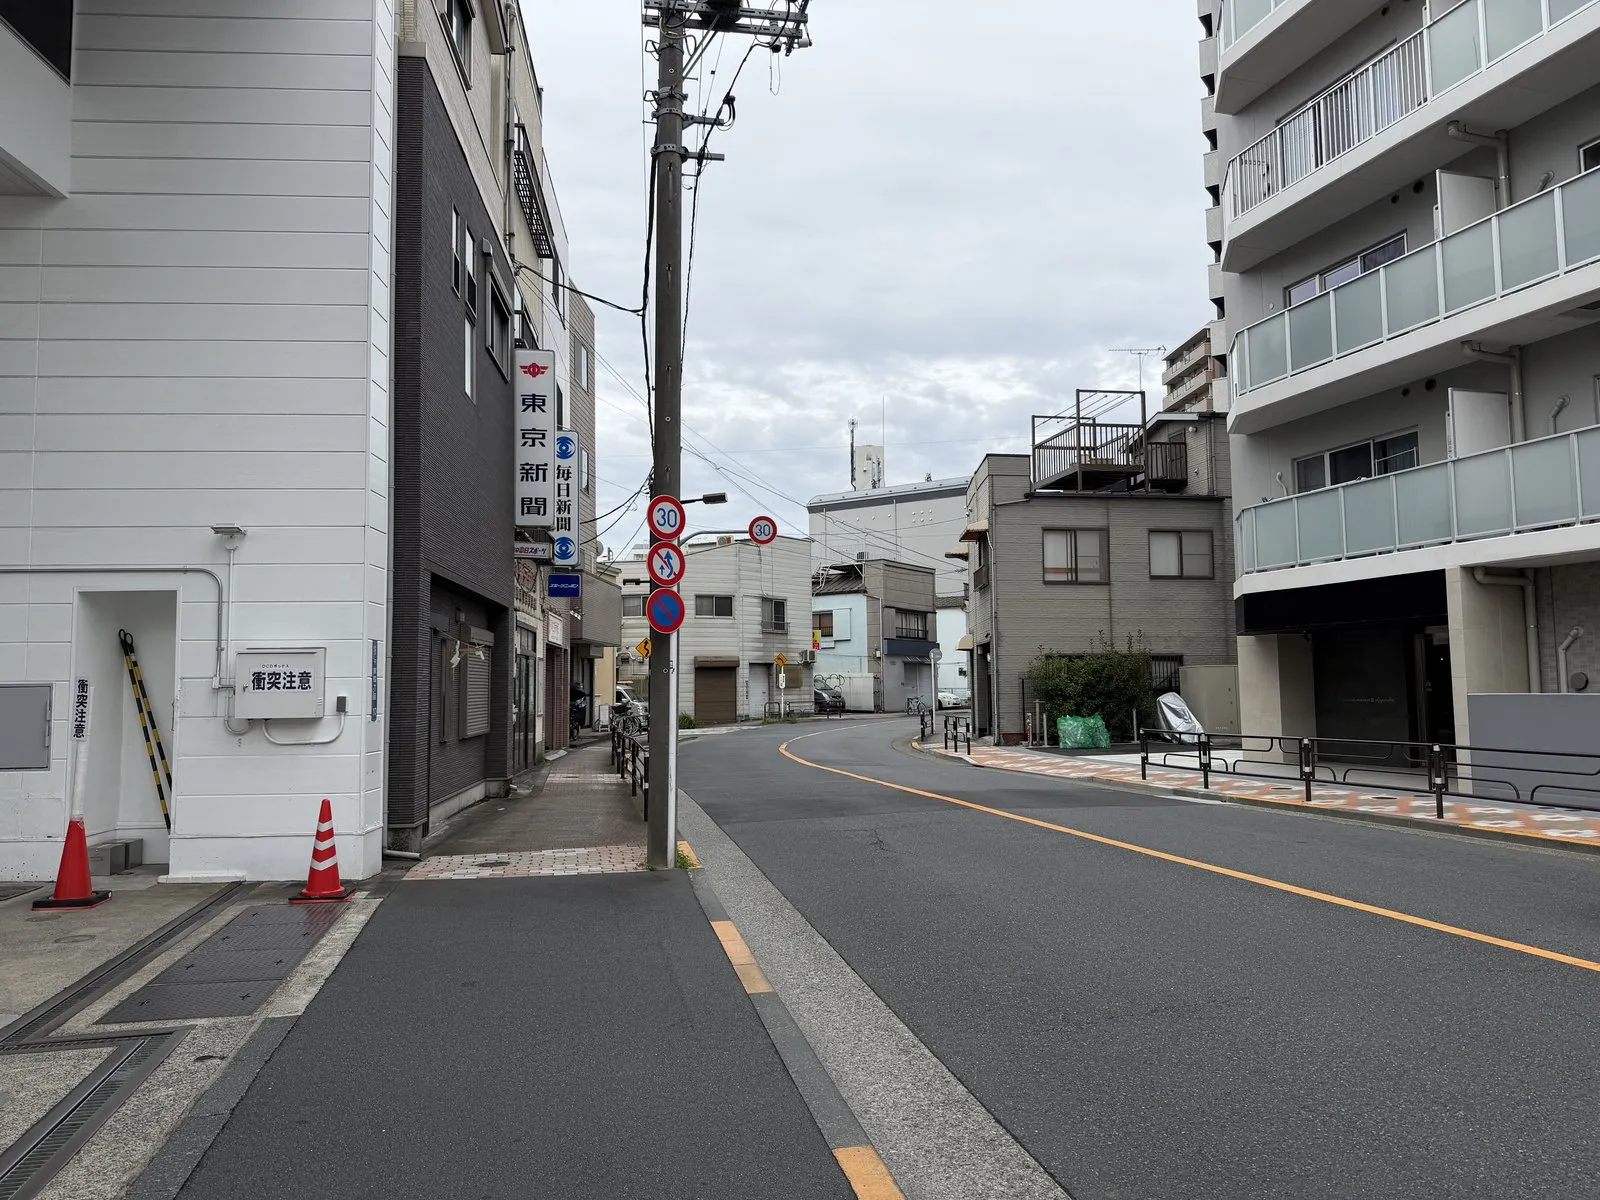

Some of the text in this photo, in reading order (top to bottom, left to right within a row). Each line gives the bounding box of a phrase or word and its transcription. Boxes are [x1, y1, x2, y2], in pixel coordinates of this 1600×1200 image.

[519, 393, 549, 517] 東京新聞
[556, 464, 572, 532] 毎日新聞
[656, 507, 678, 528] 30
[755, 524, 771, 537] 30
[251, 671, 312, 691] 衝突注意
[73, 679, 89, 739] 衝突注意
